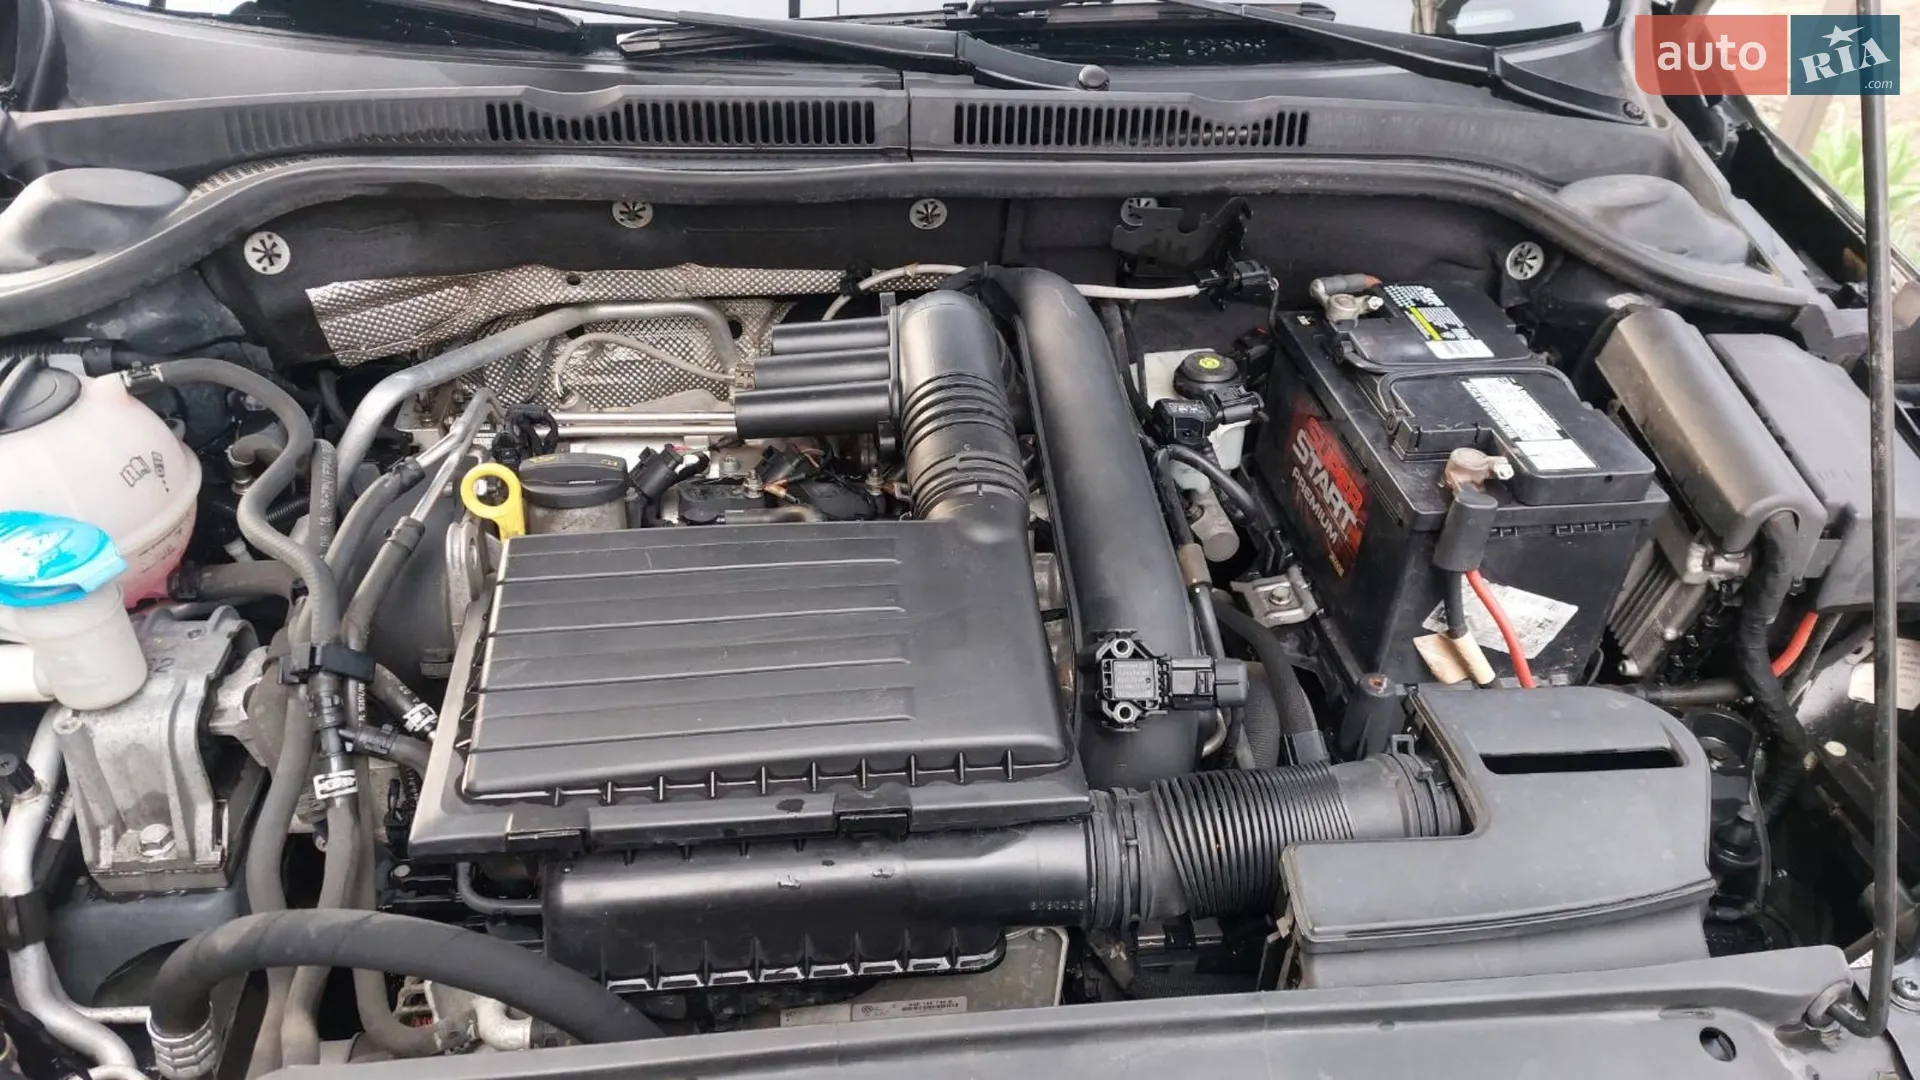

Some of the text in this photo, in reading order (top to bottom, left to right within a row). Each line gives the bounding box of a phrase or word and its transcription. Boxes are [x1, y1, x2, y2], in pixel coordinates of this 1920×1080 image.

[1291, 466, 1339, 545] PREMIUM
[1292, 428, 1358, 528] START
[1305, 416, 1363, 515] SUPER
